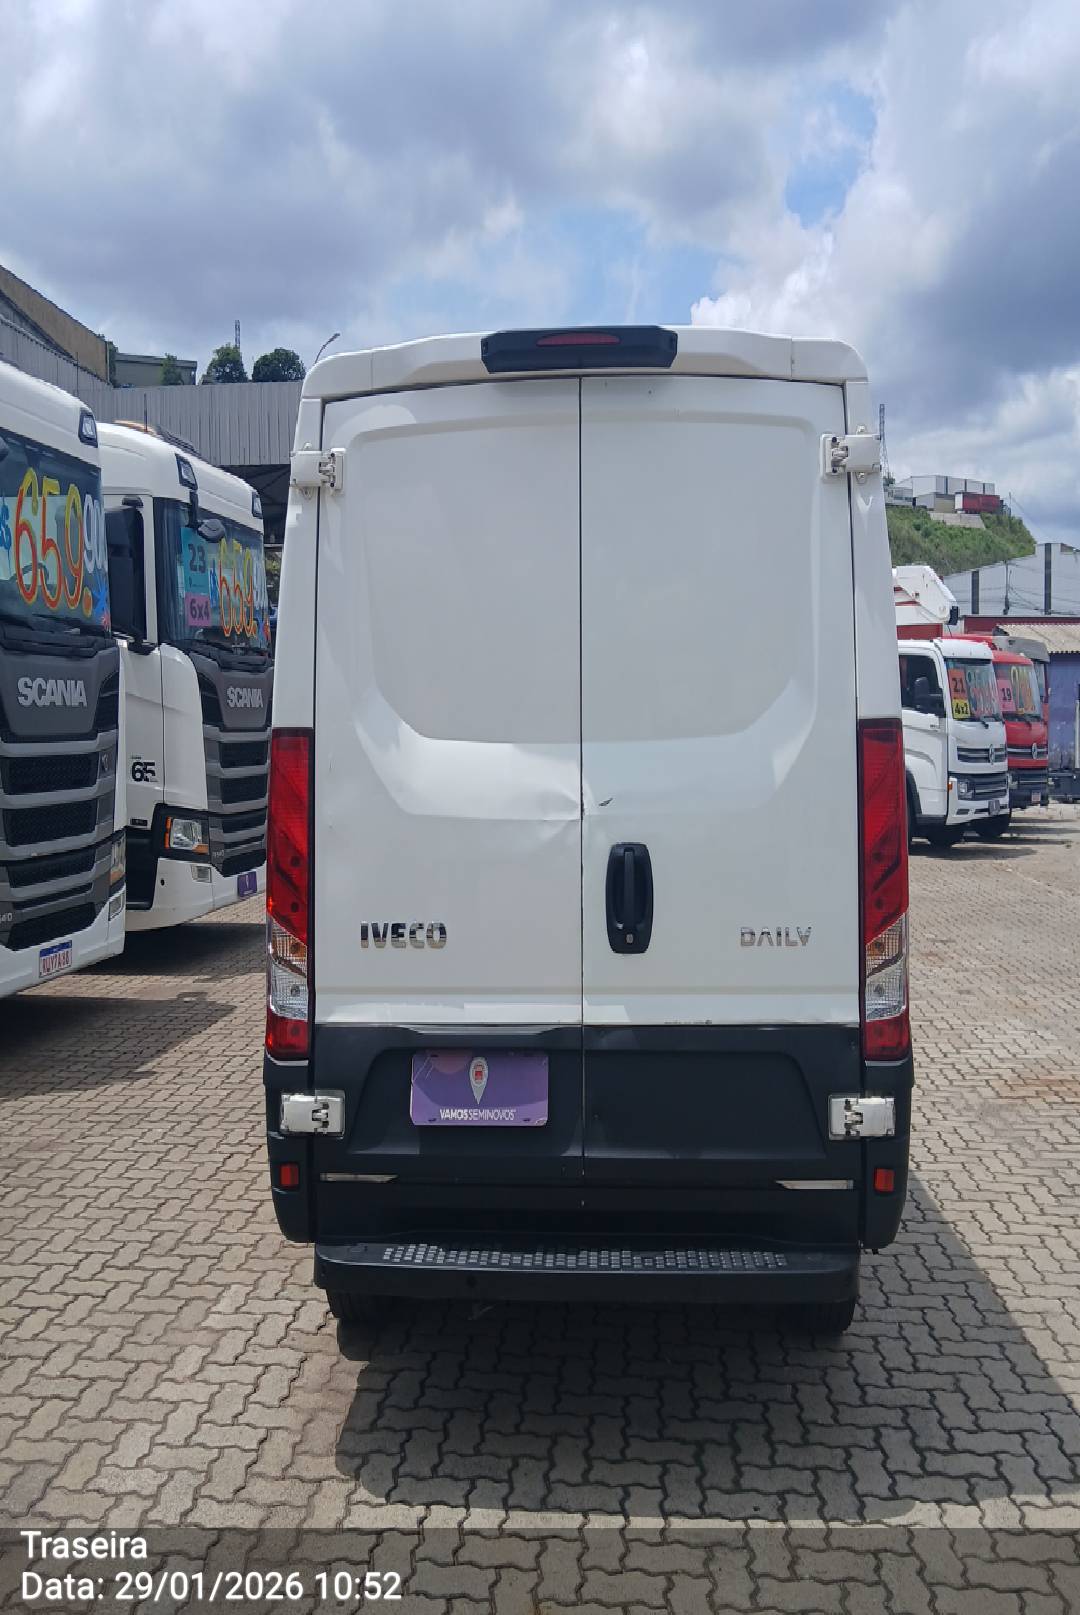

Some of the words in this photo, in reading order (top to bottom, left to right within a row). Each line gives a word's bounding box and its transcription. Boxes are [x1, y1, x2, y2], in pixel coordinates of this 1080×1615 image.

[188, 542, 207, 574] 23
[190, 598, 210, 621] 6x4
[17, 677, 88, 708] SCANIA
[226, 685, 264, 709] SCANIA
[360, 921, 447, 949] IVECO
[740, 926, 812, 947] DAILY
